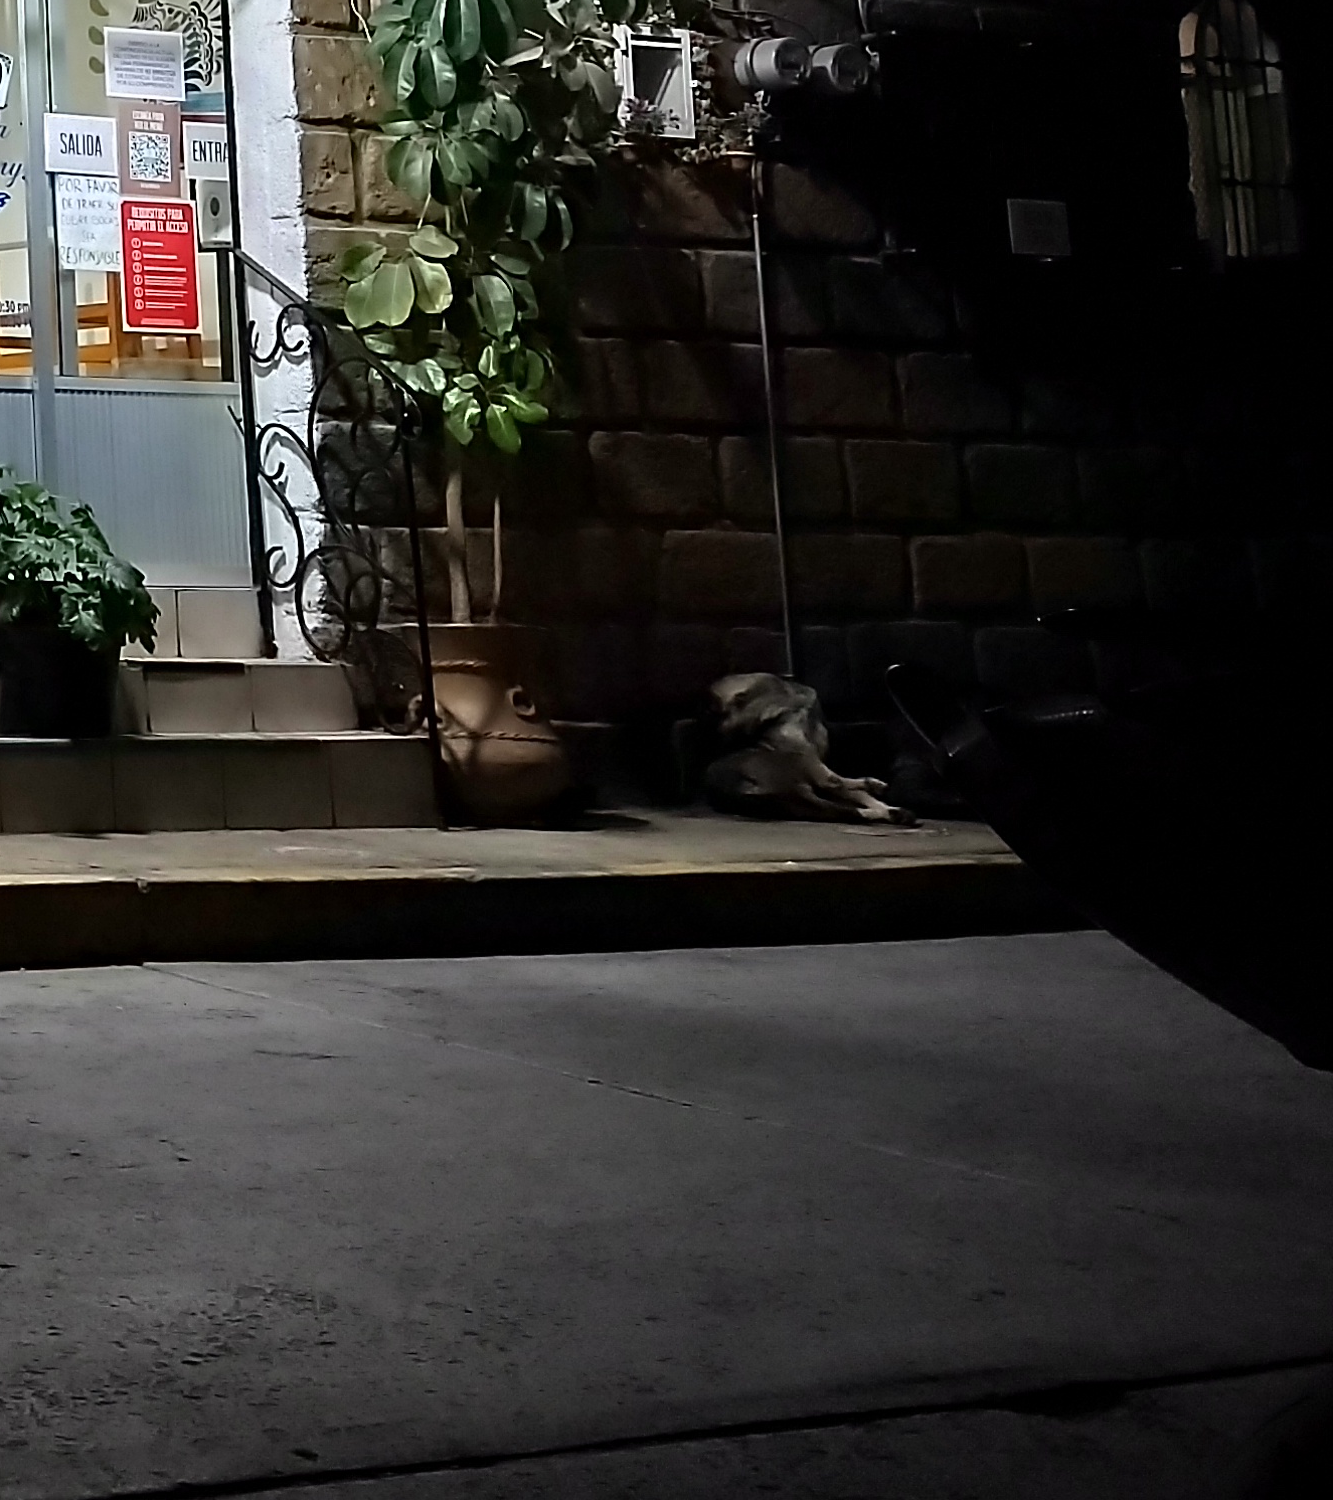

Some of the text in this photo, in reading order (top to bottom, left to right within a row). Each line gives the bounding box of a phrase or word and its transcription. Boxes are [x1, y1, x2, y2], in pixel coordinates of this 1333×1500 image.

[60, 132, 103, 157] SALIDA
[192, 140, 228, 162] ENTRA
[58, 177, 83, 193] POR
